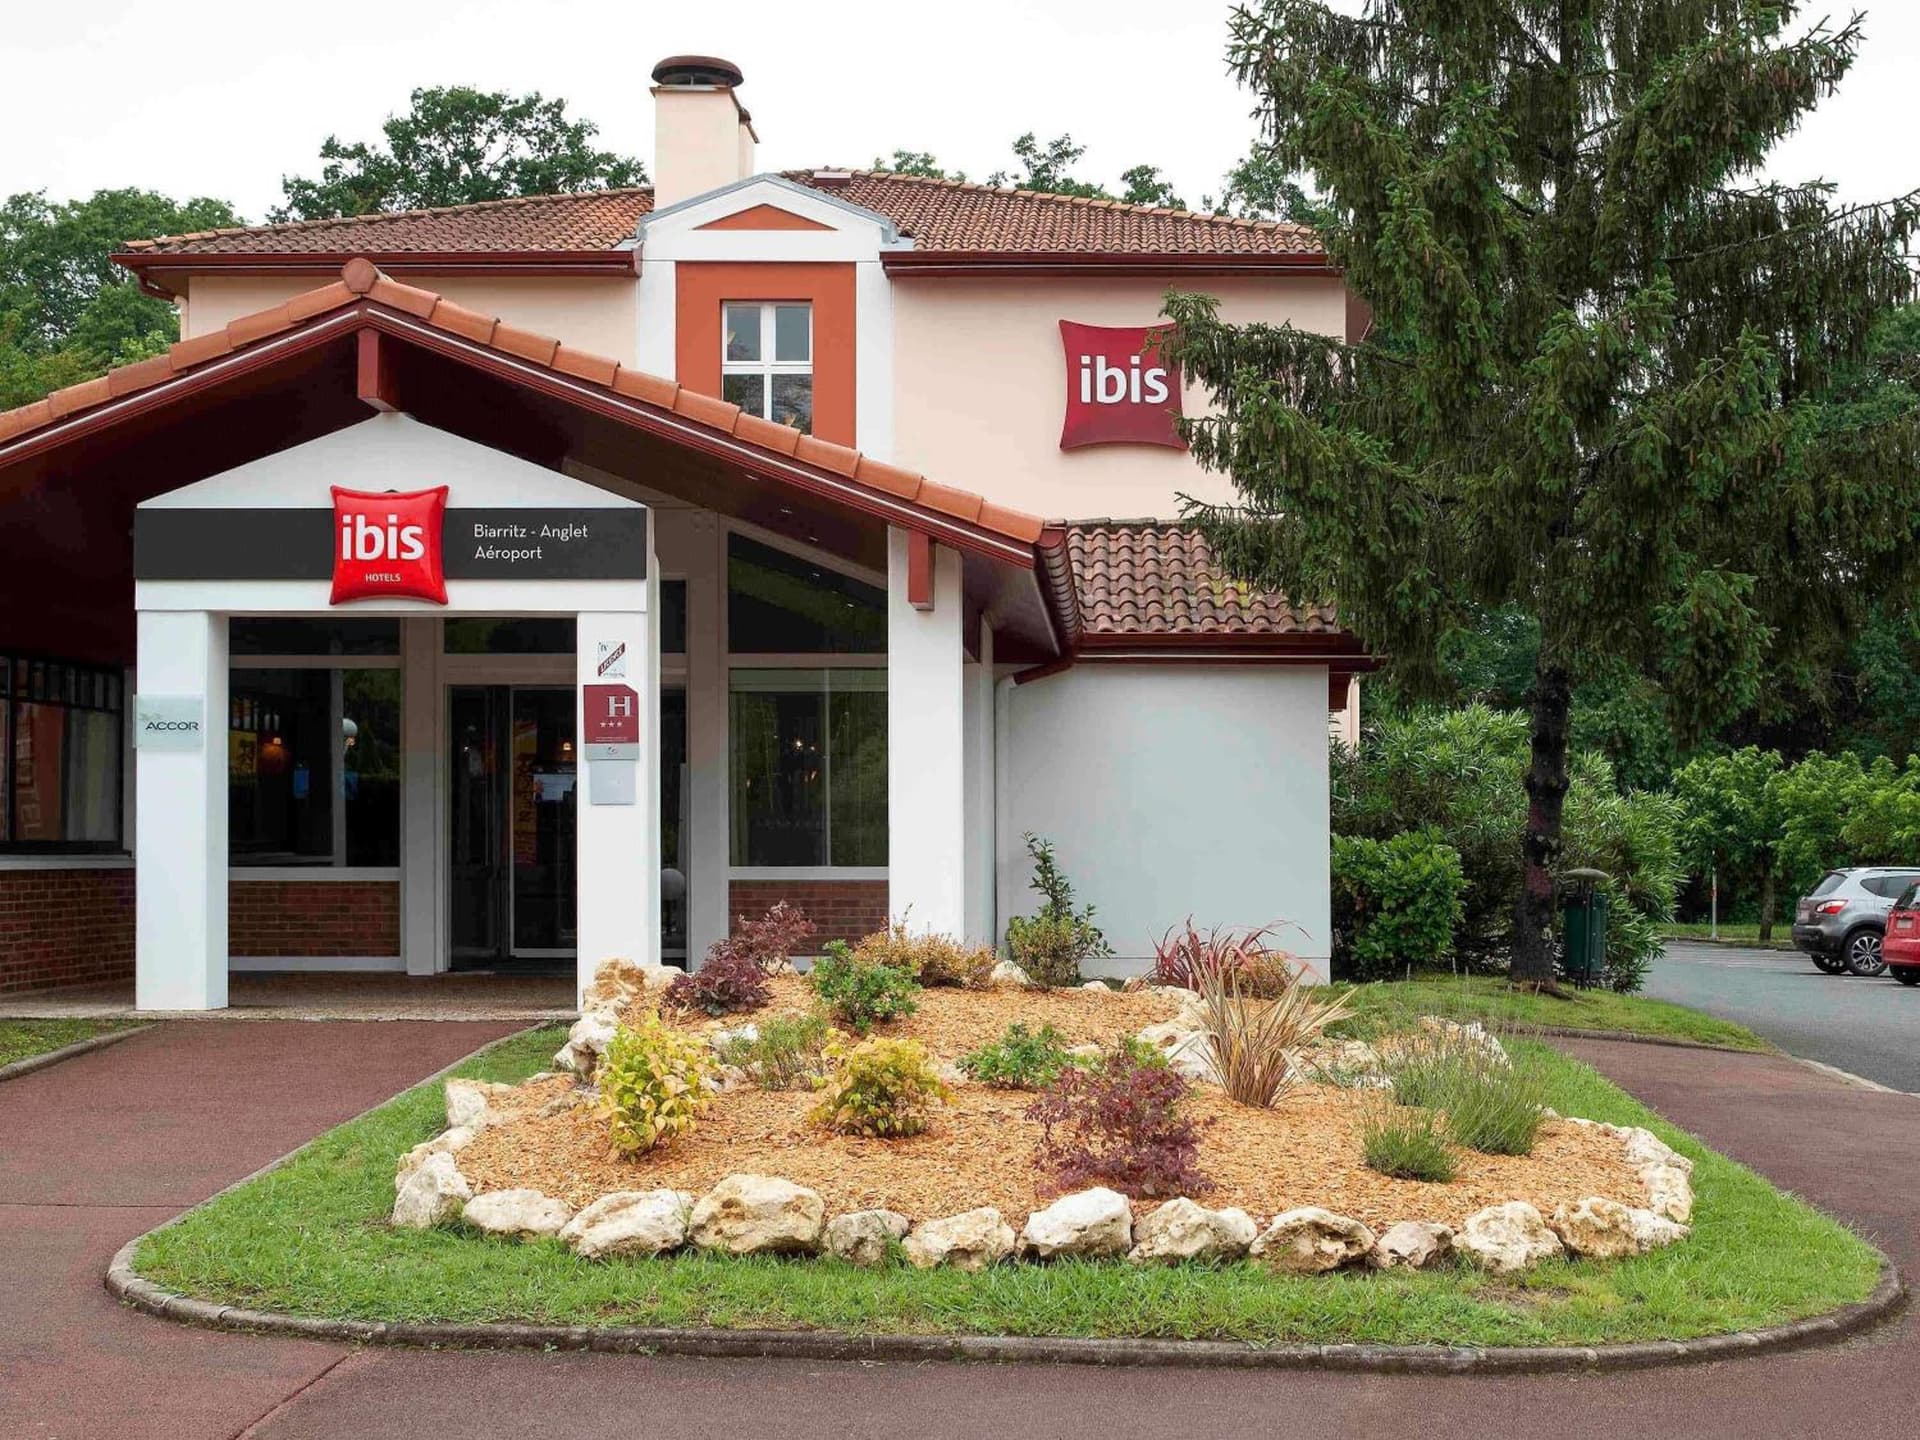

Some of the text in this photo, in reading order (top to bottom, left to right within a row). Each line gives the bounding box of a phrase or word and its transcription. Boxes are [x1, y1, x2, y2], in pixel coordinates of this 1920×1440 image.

[1080, 355, 1169, 404] ibis
[342, 514, 425, 561] ibis
[473, 523, 527, 538] Biarritz
[540, 523, 588, 542] Anglet
[474, 545, 543, 563] Aéroport
[365, 573, 401, 582] HOTELS
[607, 695, 632, 718] H
[145, 721, 199, 731] ACCOR
